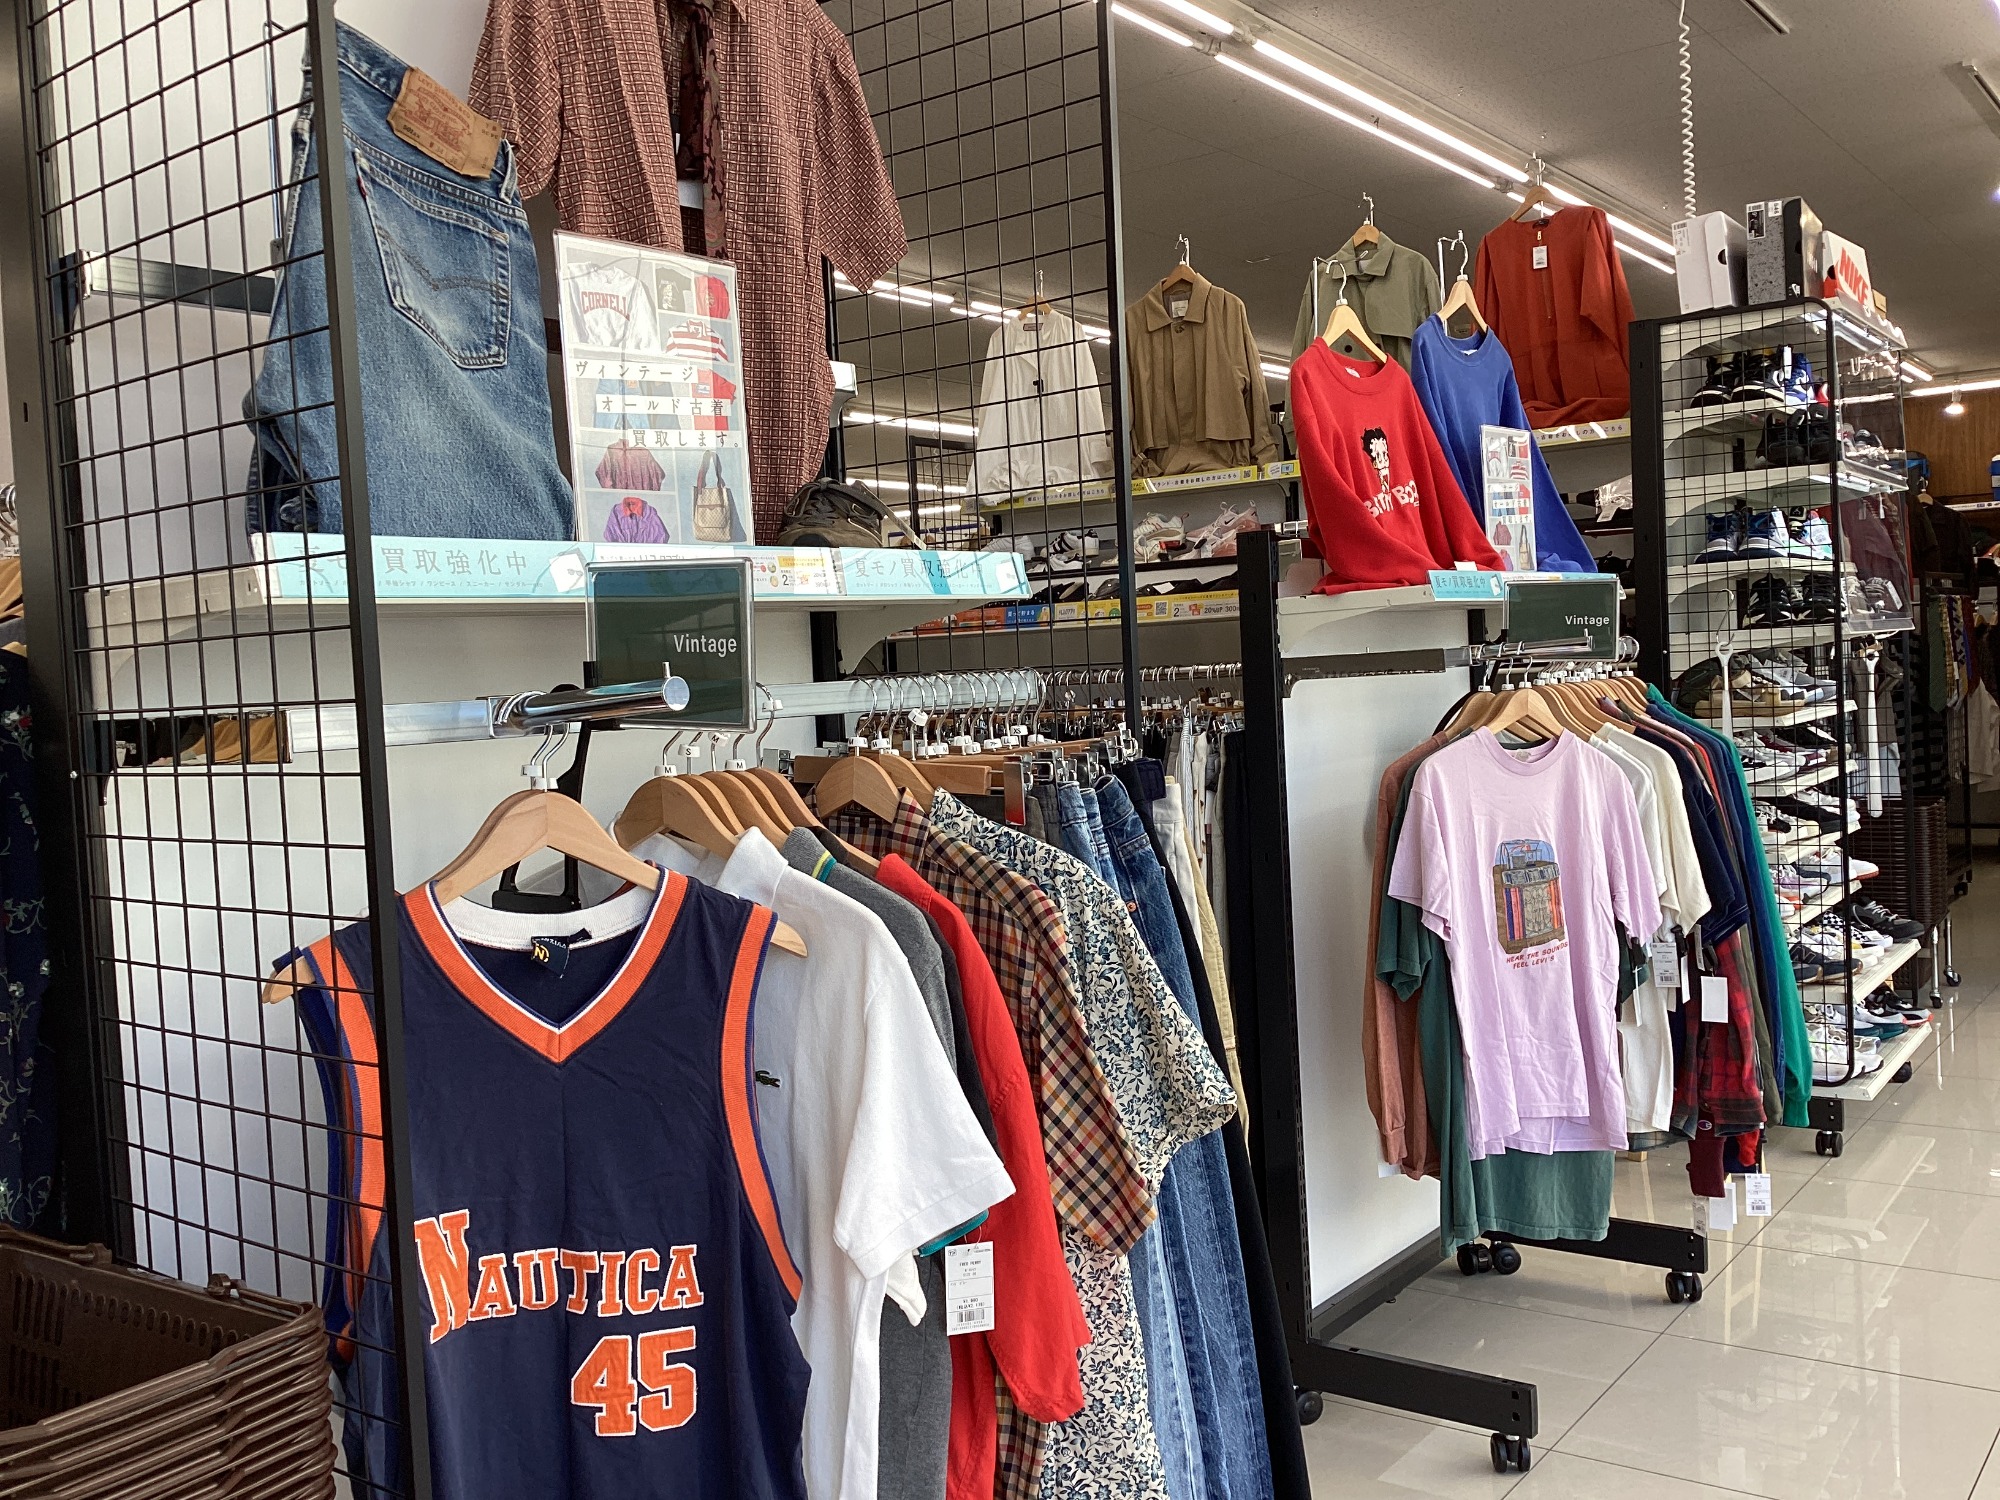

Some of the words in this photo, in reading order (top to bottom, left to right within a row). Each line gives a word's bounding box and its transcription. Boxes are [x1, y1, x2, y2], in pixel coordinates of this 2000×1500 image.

[1839, 247, 1871, 305] NIKE
[581, 291, 630, 321] CORNELL
[576, 361, 693, 381] ヴィンテージ
[601, 397, 724, 416] オールド古着
[632, 430, 739, 448] 買取します。
[293, 546, 527, 576] 夏モ買取強化中
[855, 558, 984, 579] 夏モノ買取強化中
[1565, 615, 1610, 627] Vintage
[673, 634, 738, 658] Vintage
[711, 735, 720, 743] M
[685, 748, 692, 756] S
[664, 766, 672, 774] M
[1506, 954, 1524, 964] HEAR
[1527, 950, 1539, 960] THE
[1541, 942, 1569, 956] SOUNDS
[1513, 961, 1529, 970] FEEL
[413, 1208, 704, 1344] NAUTICA
[571, 1325, 698, 1437] 45
